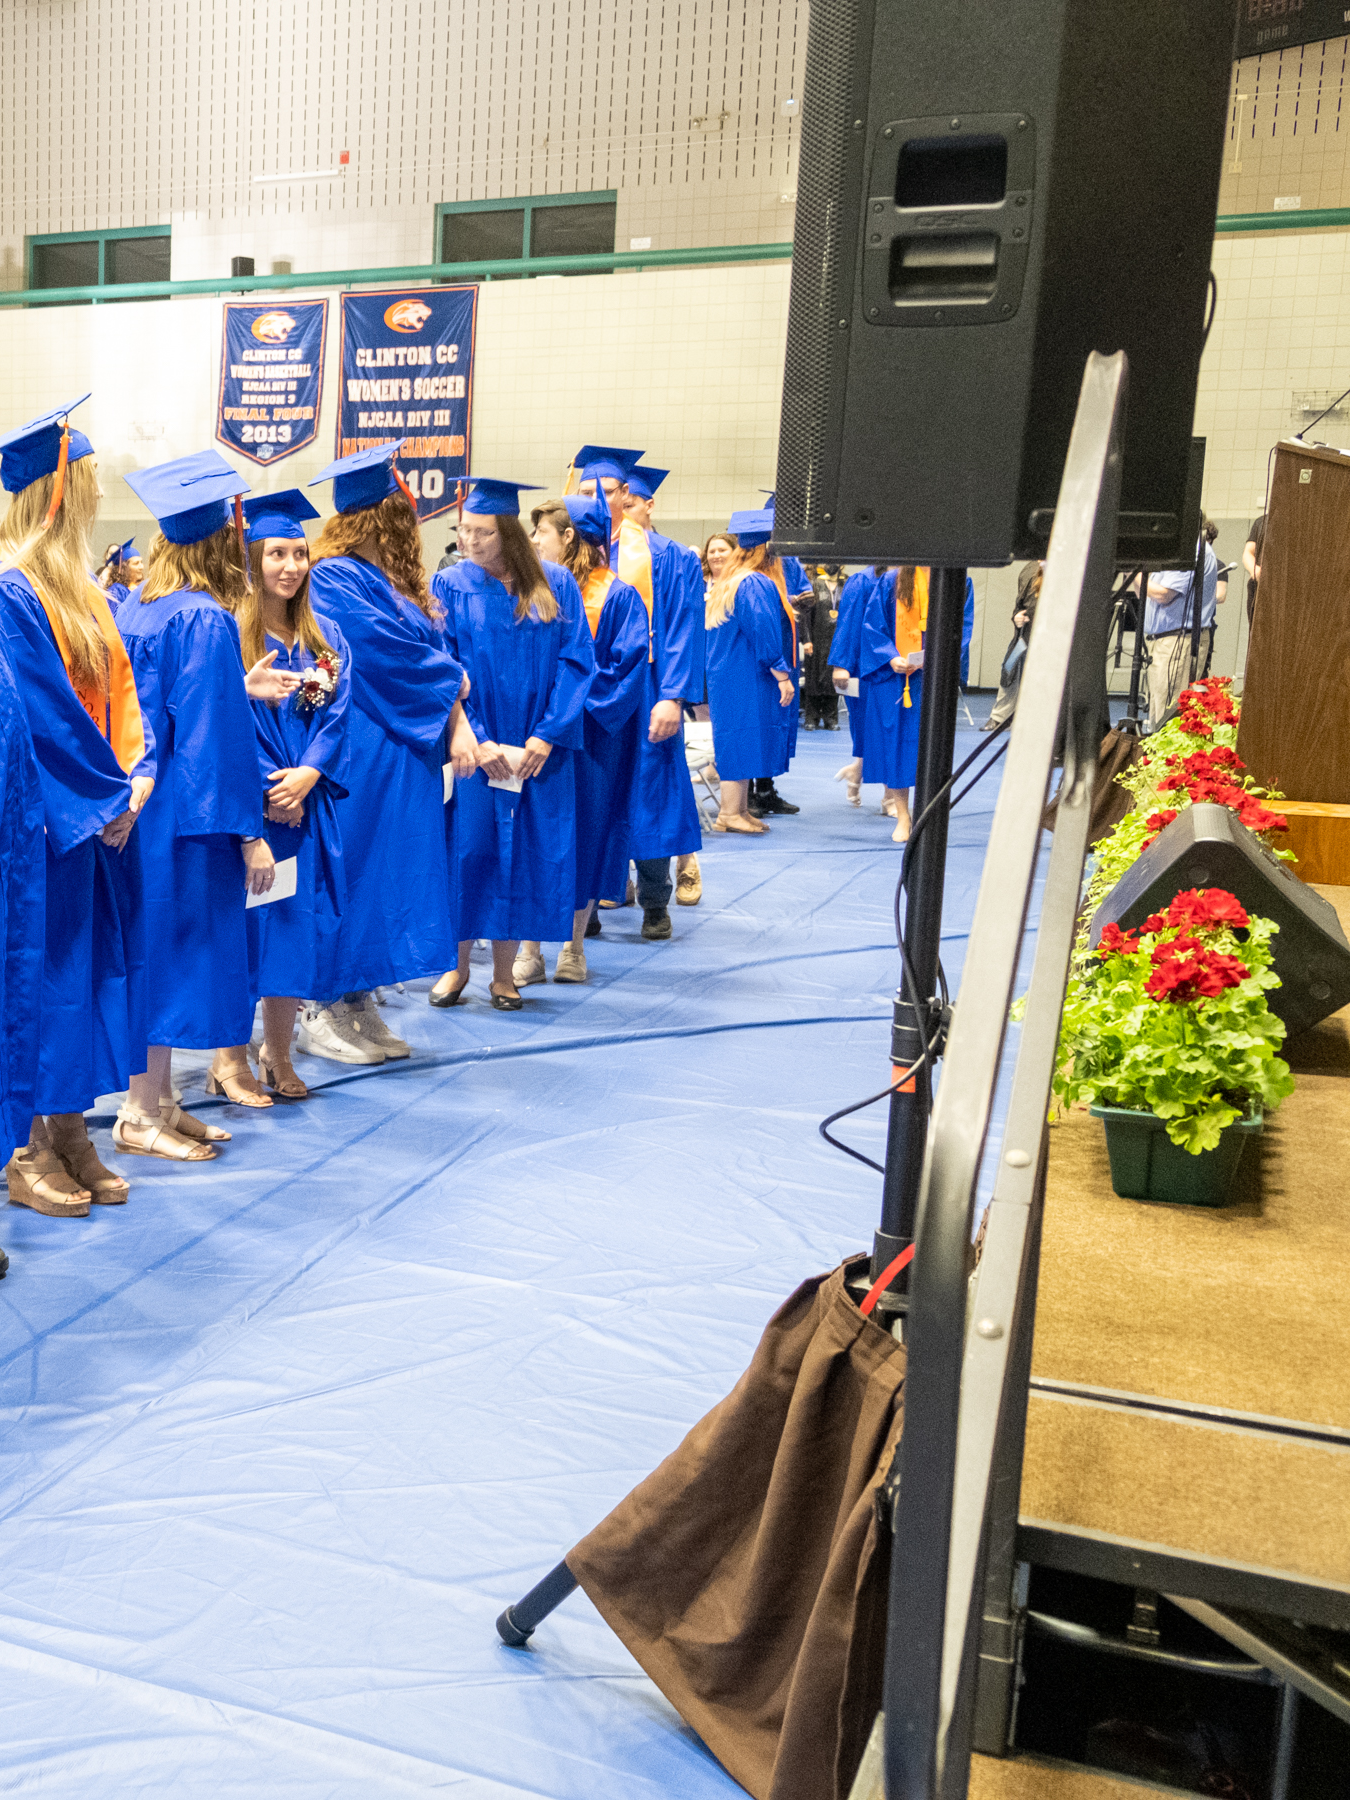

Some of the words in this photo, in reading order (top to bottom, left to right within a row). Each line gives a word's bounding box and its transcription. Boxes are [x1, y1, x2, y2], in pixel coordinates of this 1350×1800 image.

[1256, 24, 1289, 45] game
[242, 349, 286, 361] CLINTON
[288, 349, 302, 360] CC
[356, 346, 432, 367] CLINTON
[436, 344, 459, 364] CC
[347, 379, 411, 402] WOMEN'S
[414, 376, 465, 399] SOCCER
[241, 395, 285, 405] REGION
[224, 408, 269, 421] FINAL
[273, 407, 314, 421] FOUR
[358, 411, 404, 428] NJCAA
[407, 410, 431, 427] DIV
[434, 410, 451, 426] III
[241, 425, 292, 443] 2013
[400, 435, 465, 458] CHAMPIONS
